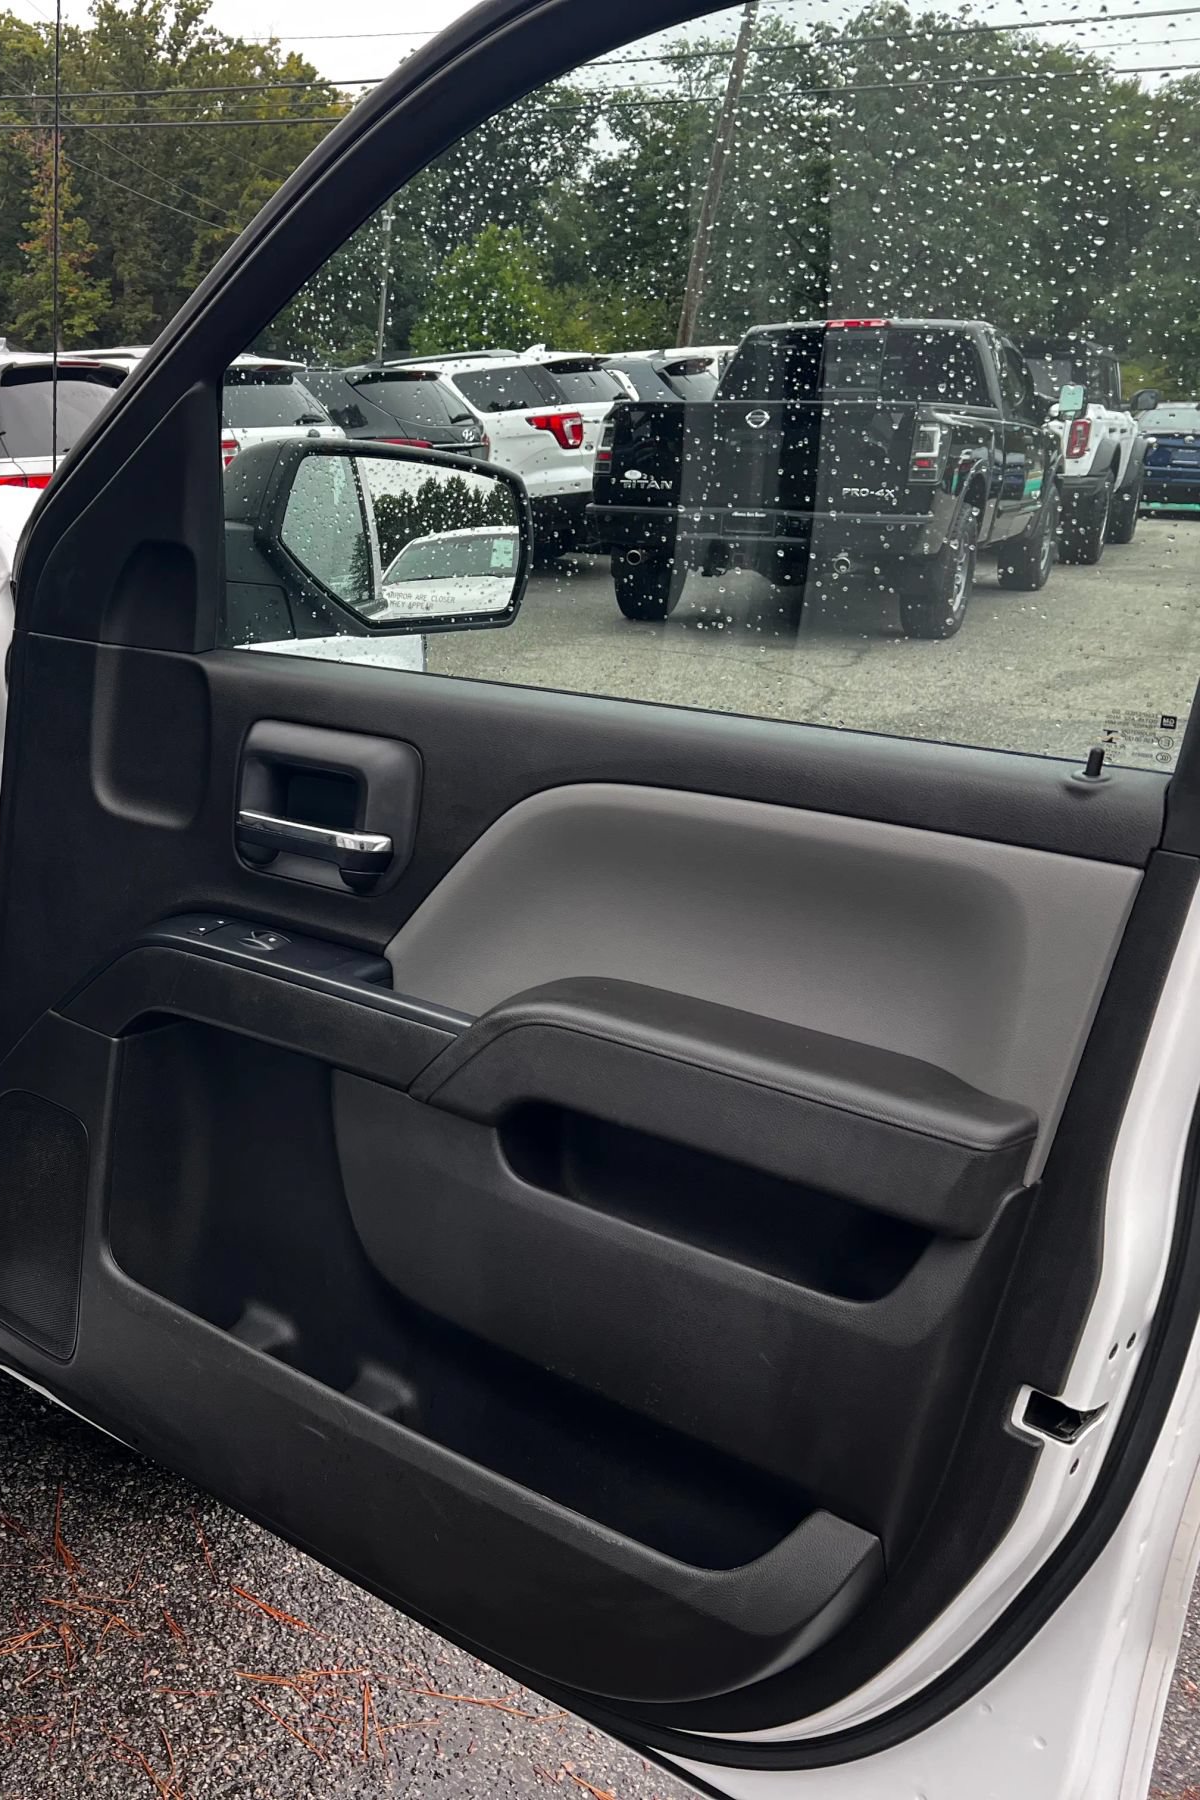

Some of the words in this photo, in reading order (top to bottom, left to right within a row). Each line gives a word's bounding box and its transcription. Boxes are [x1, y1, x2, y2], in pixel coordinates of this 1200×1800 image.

[619, 479, 673, 490] TITAN
[842, 487, 895, 499] PRO-4X
[415, 594, 427, 602] ARE
[431, 595, 456, 603] CLOSER
[407, 602, 434, 610] APPEAR
